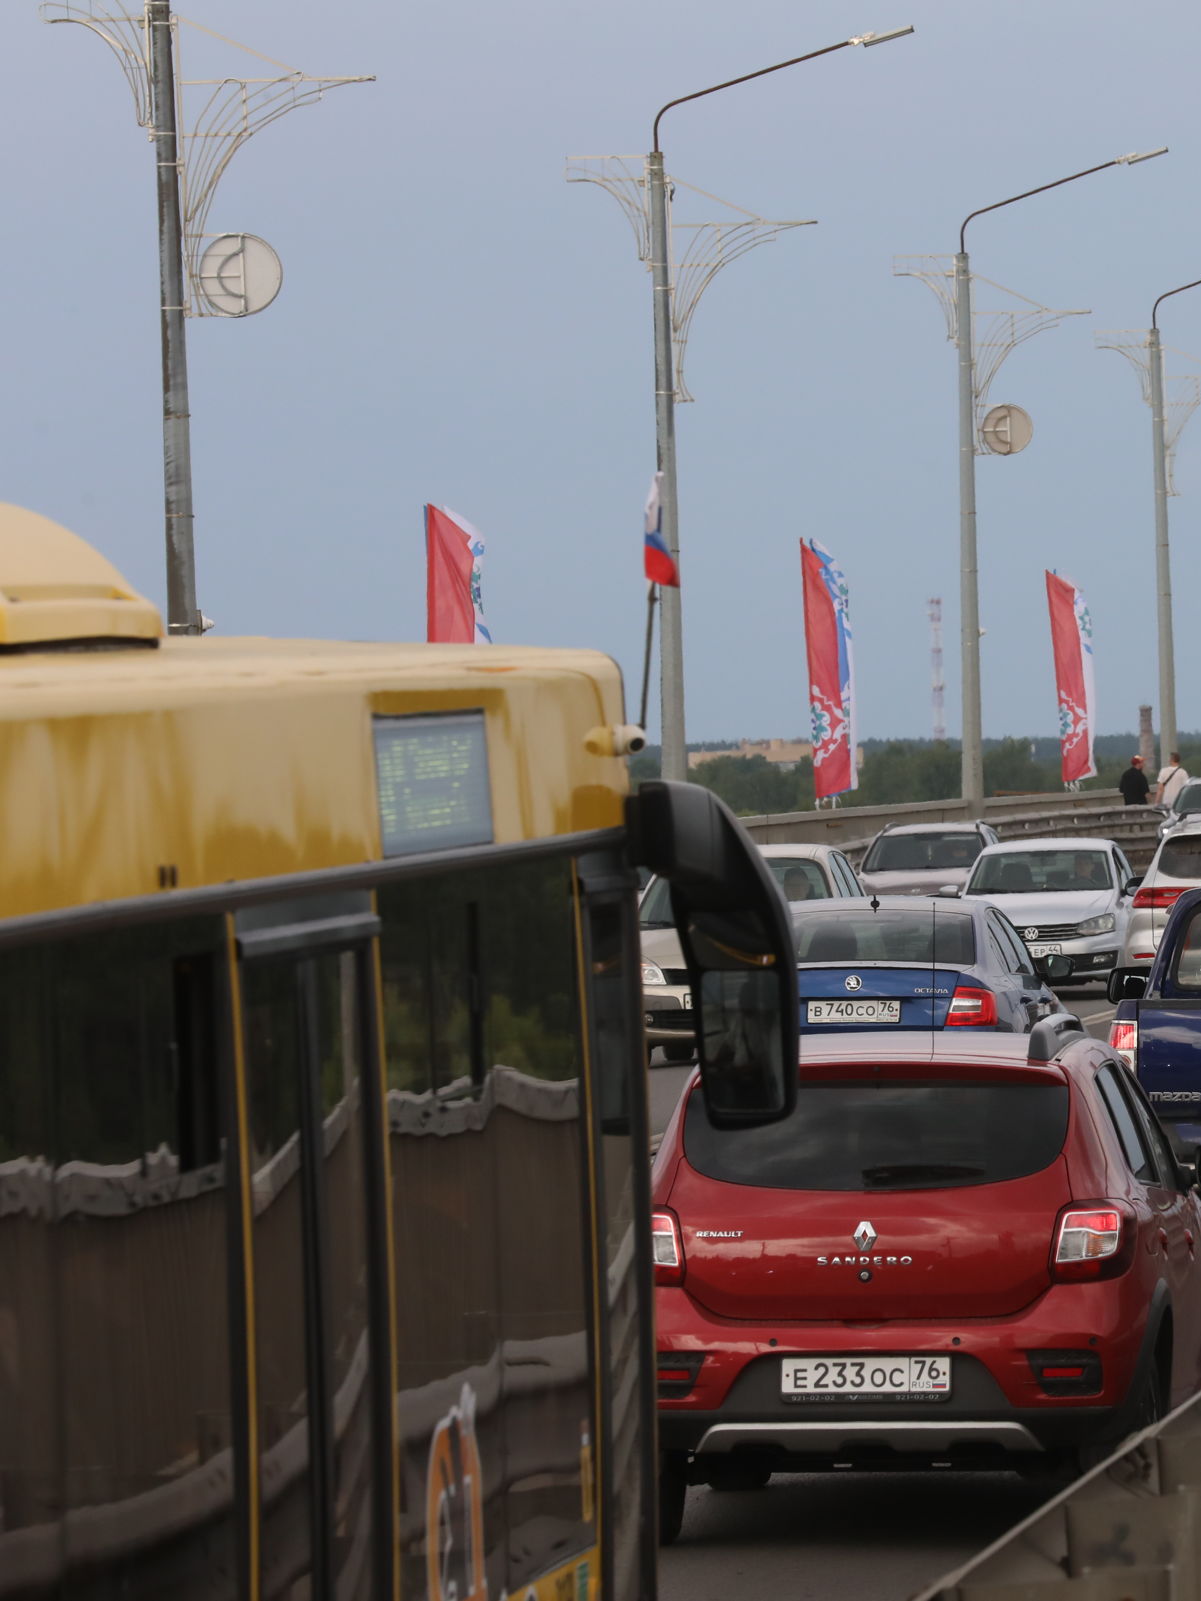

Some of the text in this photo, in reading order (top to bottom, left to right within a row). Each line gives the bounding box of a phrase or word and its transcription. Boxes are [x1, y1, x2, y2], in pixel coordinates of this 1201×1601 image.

[880, 1001, 895, 1013] 76
[695, 1230, 744, 1238] RENAULT
[816, 1255, 913, 1266] SANDERO
[913, 1360, 941, 1381] 76
[911, 1381, 931, 1389] RUS
